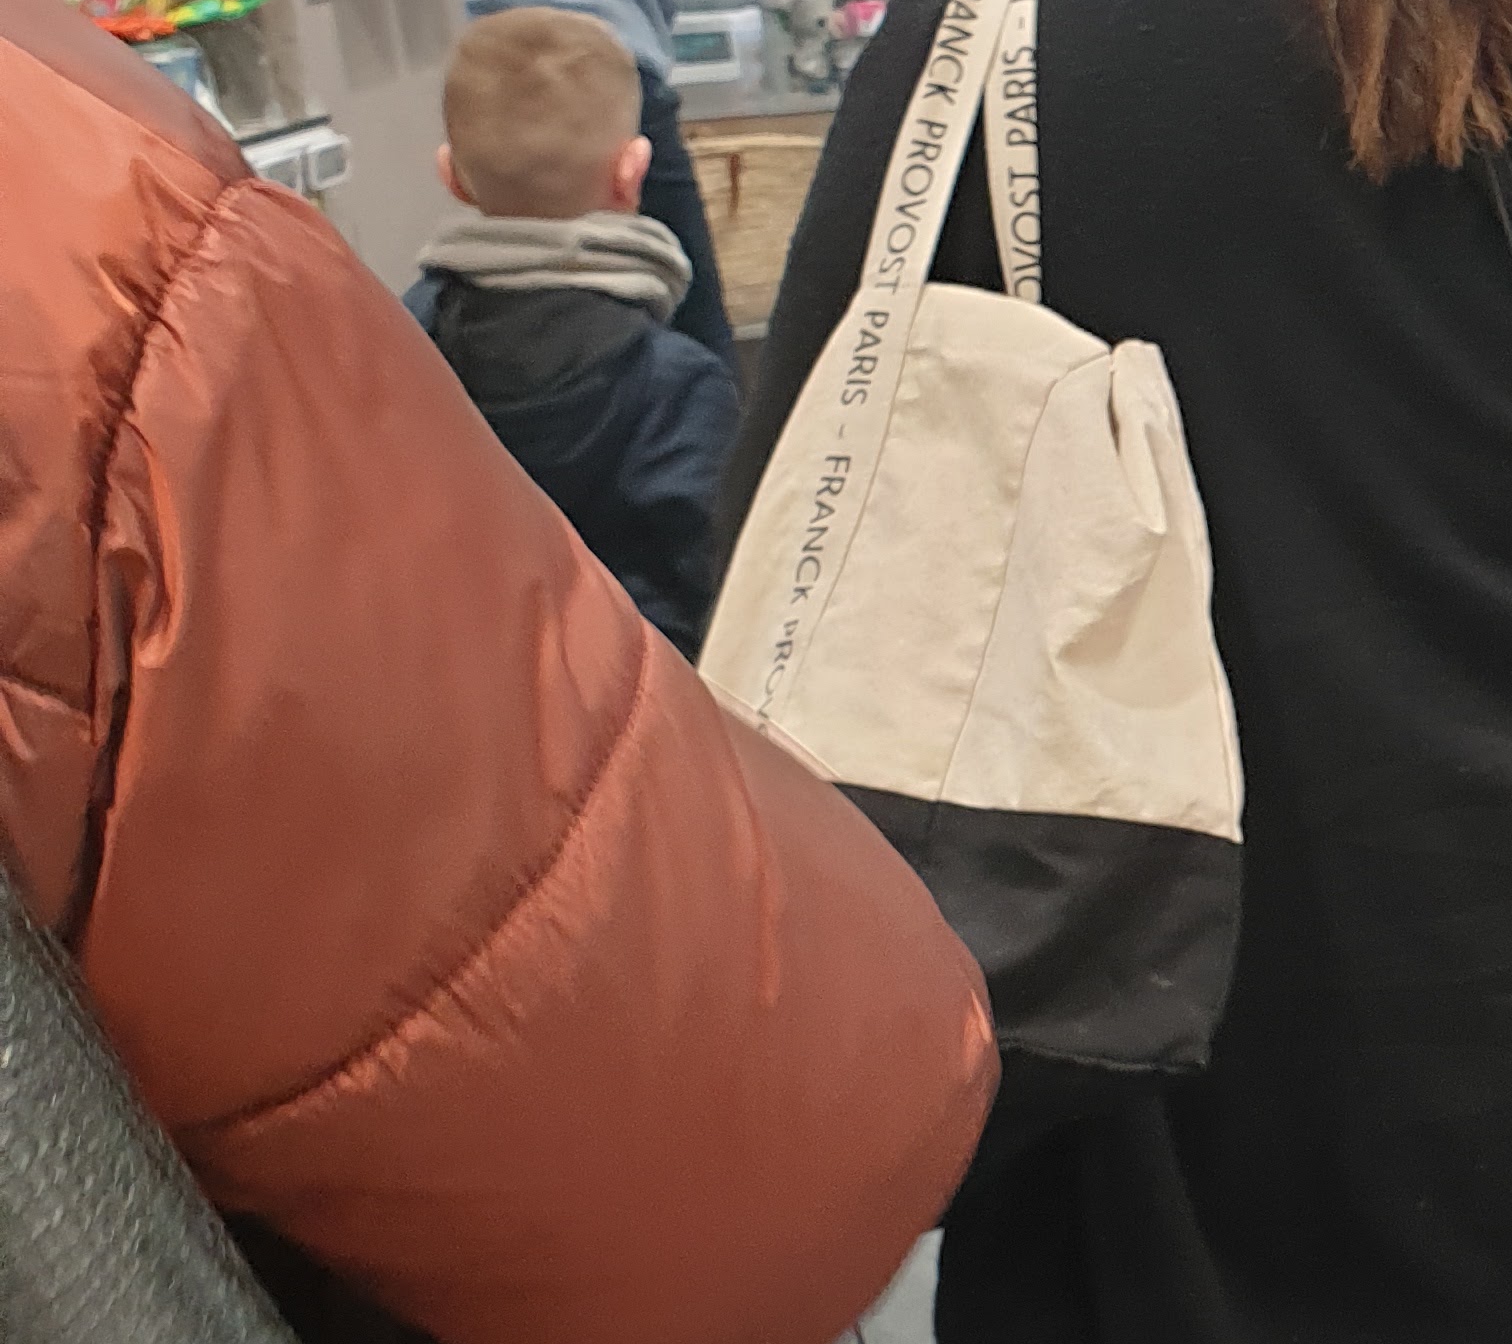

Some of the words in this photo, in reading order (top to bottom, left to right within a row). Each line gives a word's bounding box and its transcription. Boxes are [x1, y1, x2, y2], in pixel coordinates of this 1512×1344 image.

[875, 118, 948, 296] PROVOST
[1009, 166, 1042, 306] OVOST
[840, 310, 890, 407] PARIS
[790, 456, 852, 604] FRANCK
[755, 619, 799, 737] PROV
